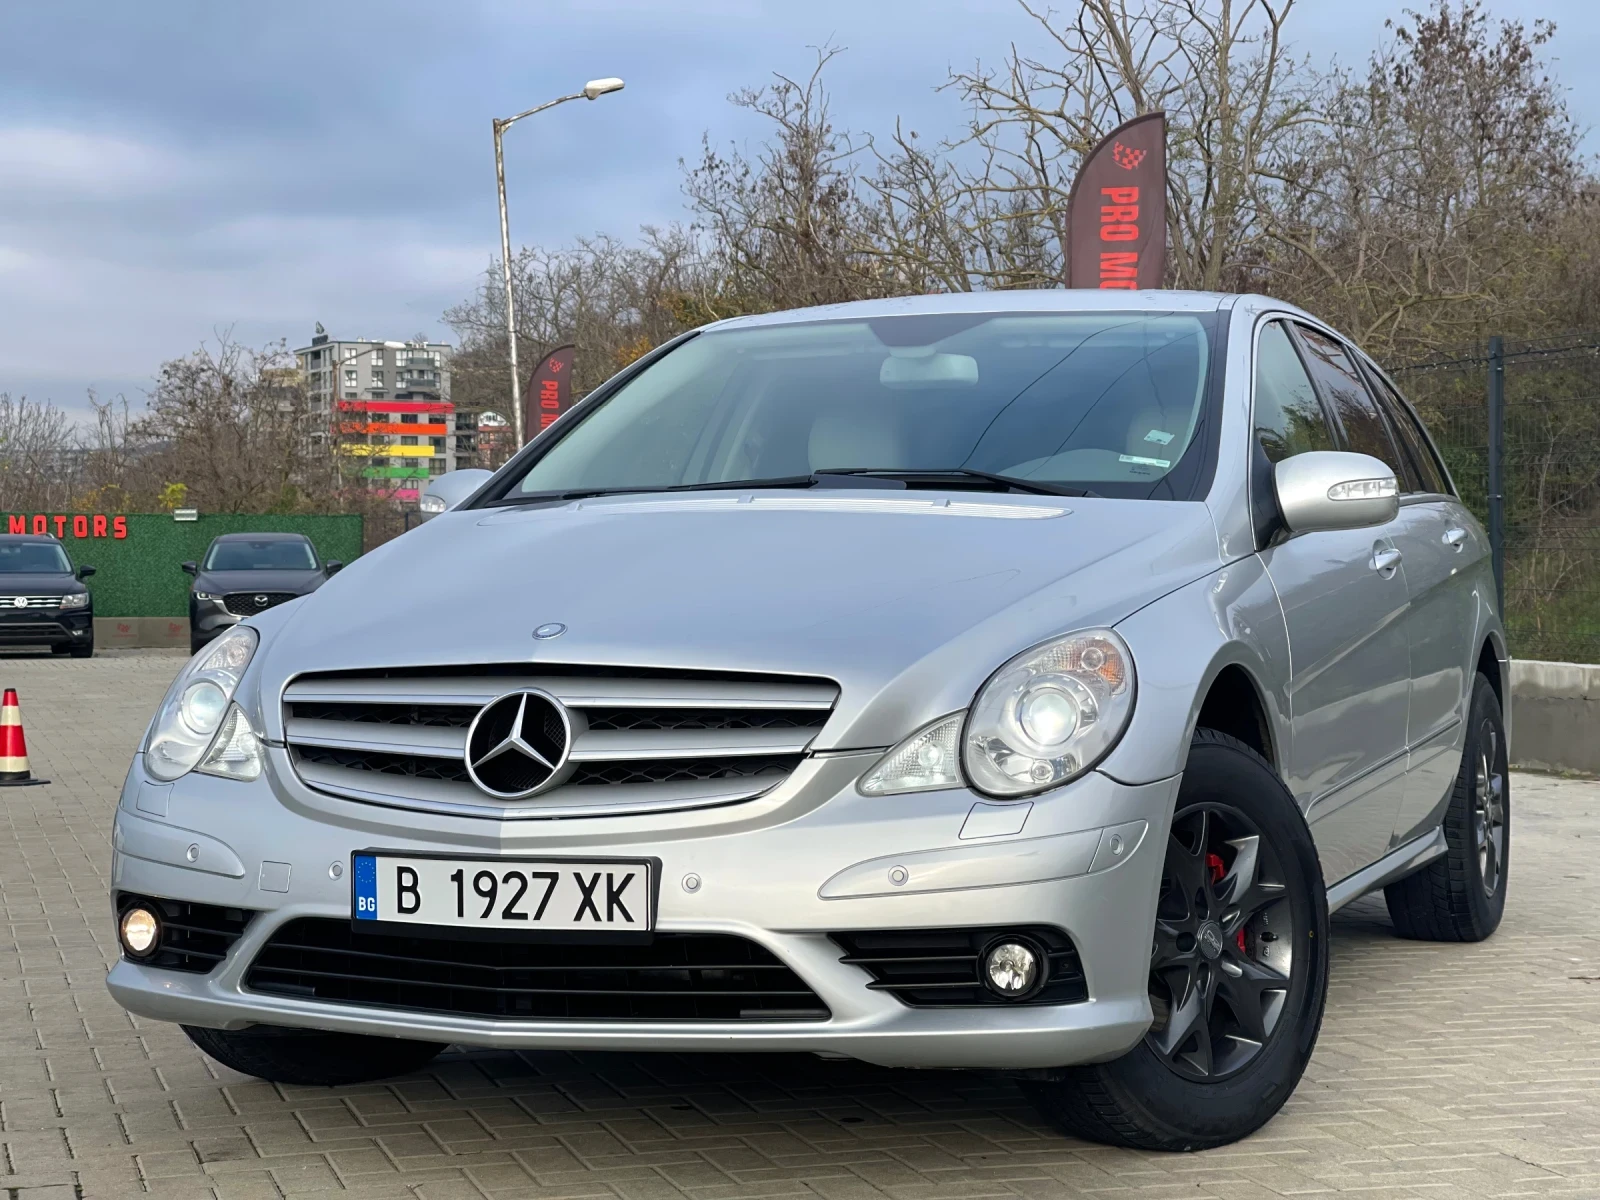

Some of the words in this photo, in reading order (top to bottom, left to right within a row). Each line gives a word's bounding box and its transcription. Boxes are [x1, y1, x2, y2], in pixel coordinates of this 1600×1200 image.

[1100, 186, 1140, 242] PRO
[541, 380, 560, 409] PRO
[8, 514, 128, 539] MOTORS
[358, 896, 376, 912] BG
[396, 866, 421, 914] B
[450, 868, 560, 921] 1927
[572, 872, 636, 923] XK
